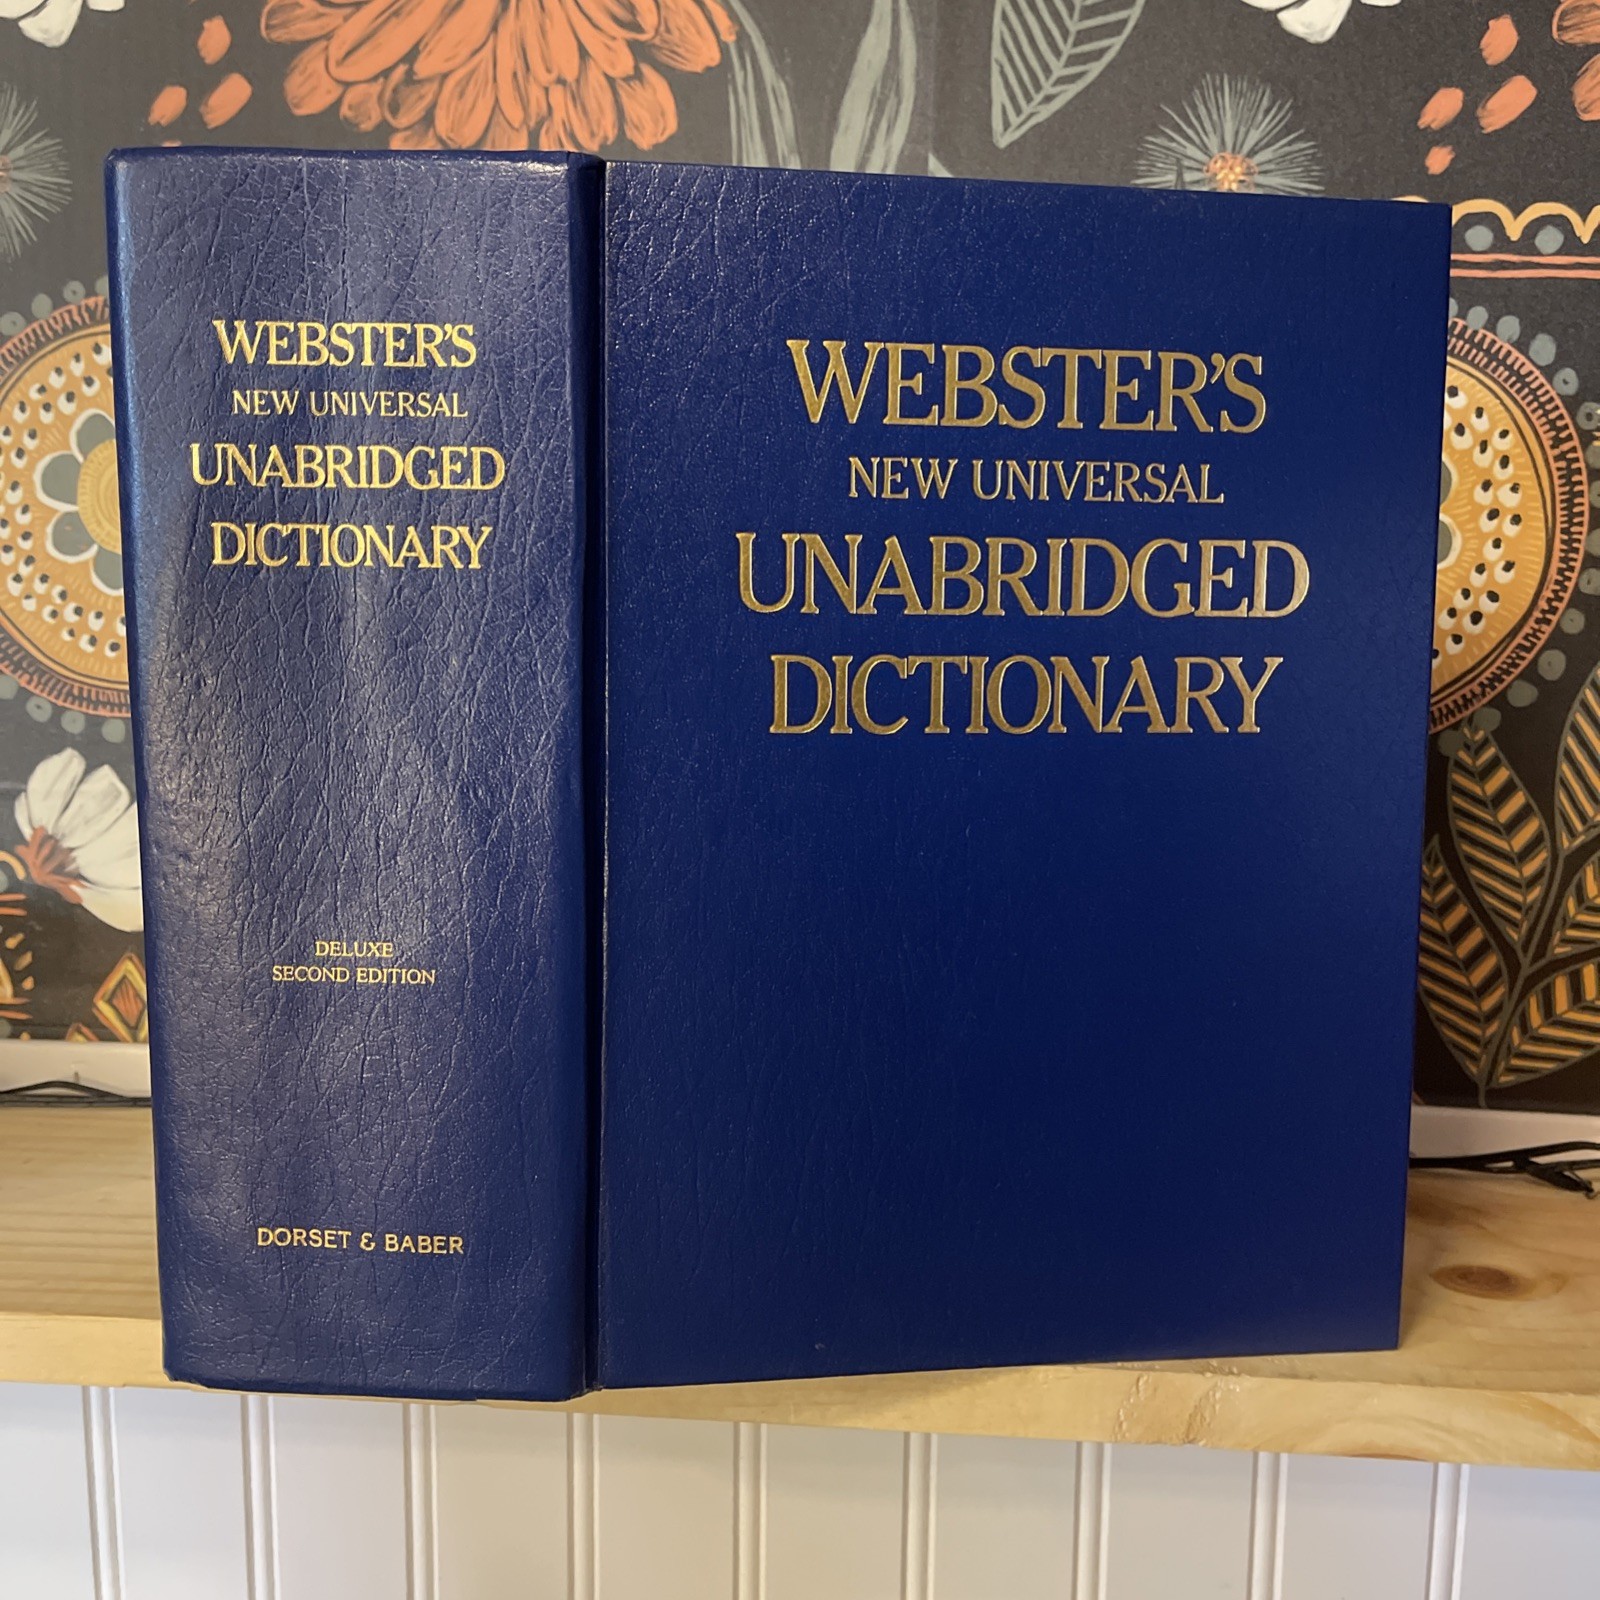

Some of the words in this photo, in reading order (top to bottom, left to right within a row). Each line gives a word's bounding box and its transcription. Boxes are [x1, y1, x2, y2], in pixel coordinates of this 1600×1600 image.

[212, 319, 477, 368] WEBSTER'S
[232, 389, 299, 416] NEW
[309, 390, 469, 419] UNIVERSAL
[786, 339, 1266, 434] WEBSTER'S
[190, 442, 506, 491] UNABRIDGED
[849, 457, 957, 499] NEW
[973, 460, 1224, 504] UNIVERSAL
[211, 521, 492, 570] DICTIONARY
[736, 532, 1310, 618] UNABRIDGED
[769, 655, 1282, 734] DICTIONARY
[315, 940, 394, 958] DELUXE
[272, 965, 350, 983] SECOND
[355, 966, 436, 985] EDITION
[257, 1226, 352, 1249] DORSET
[359, 1232, 376, 1251] &
[384, 1233, 464, 1254] BABER
